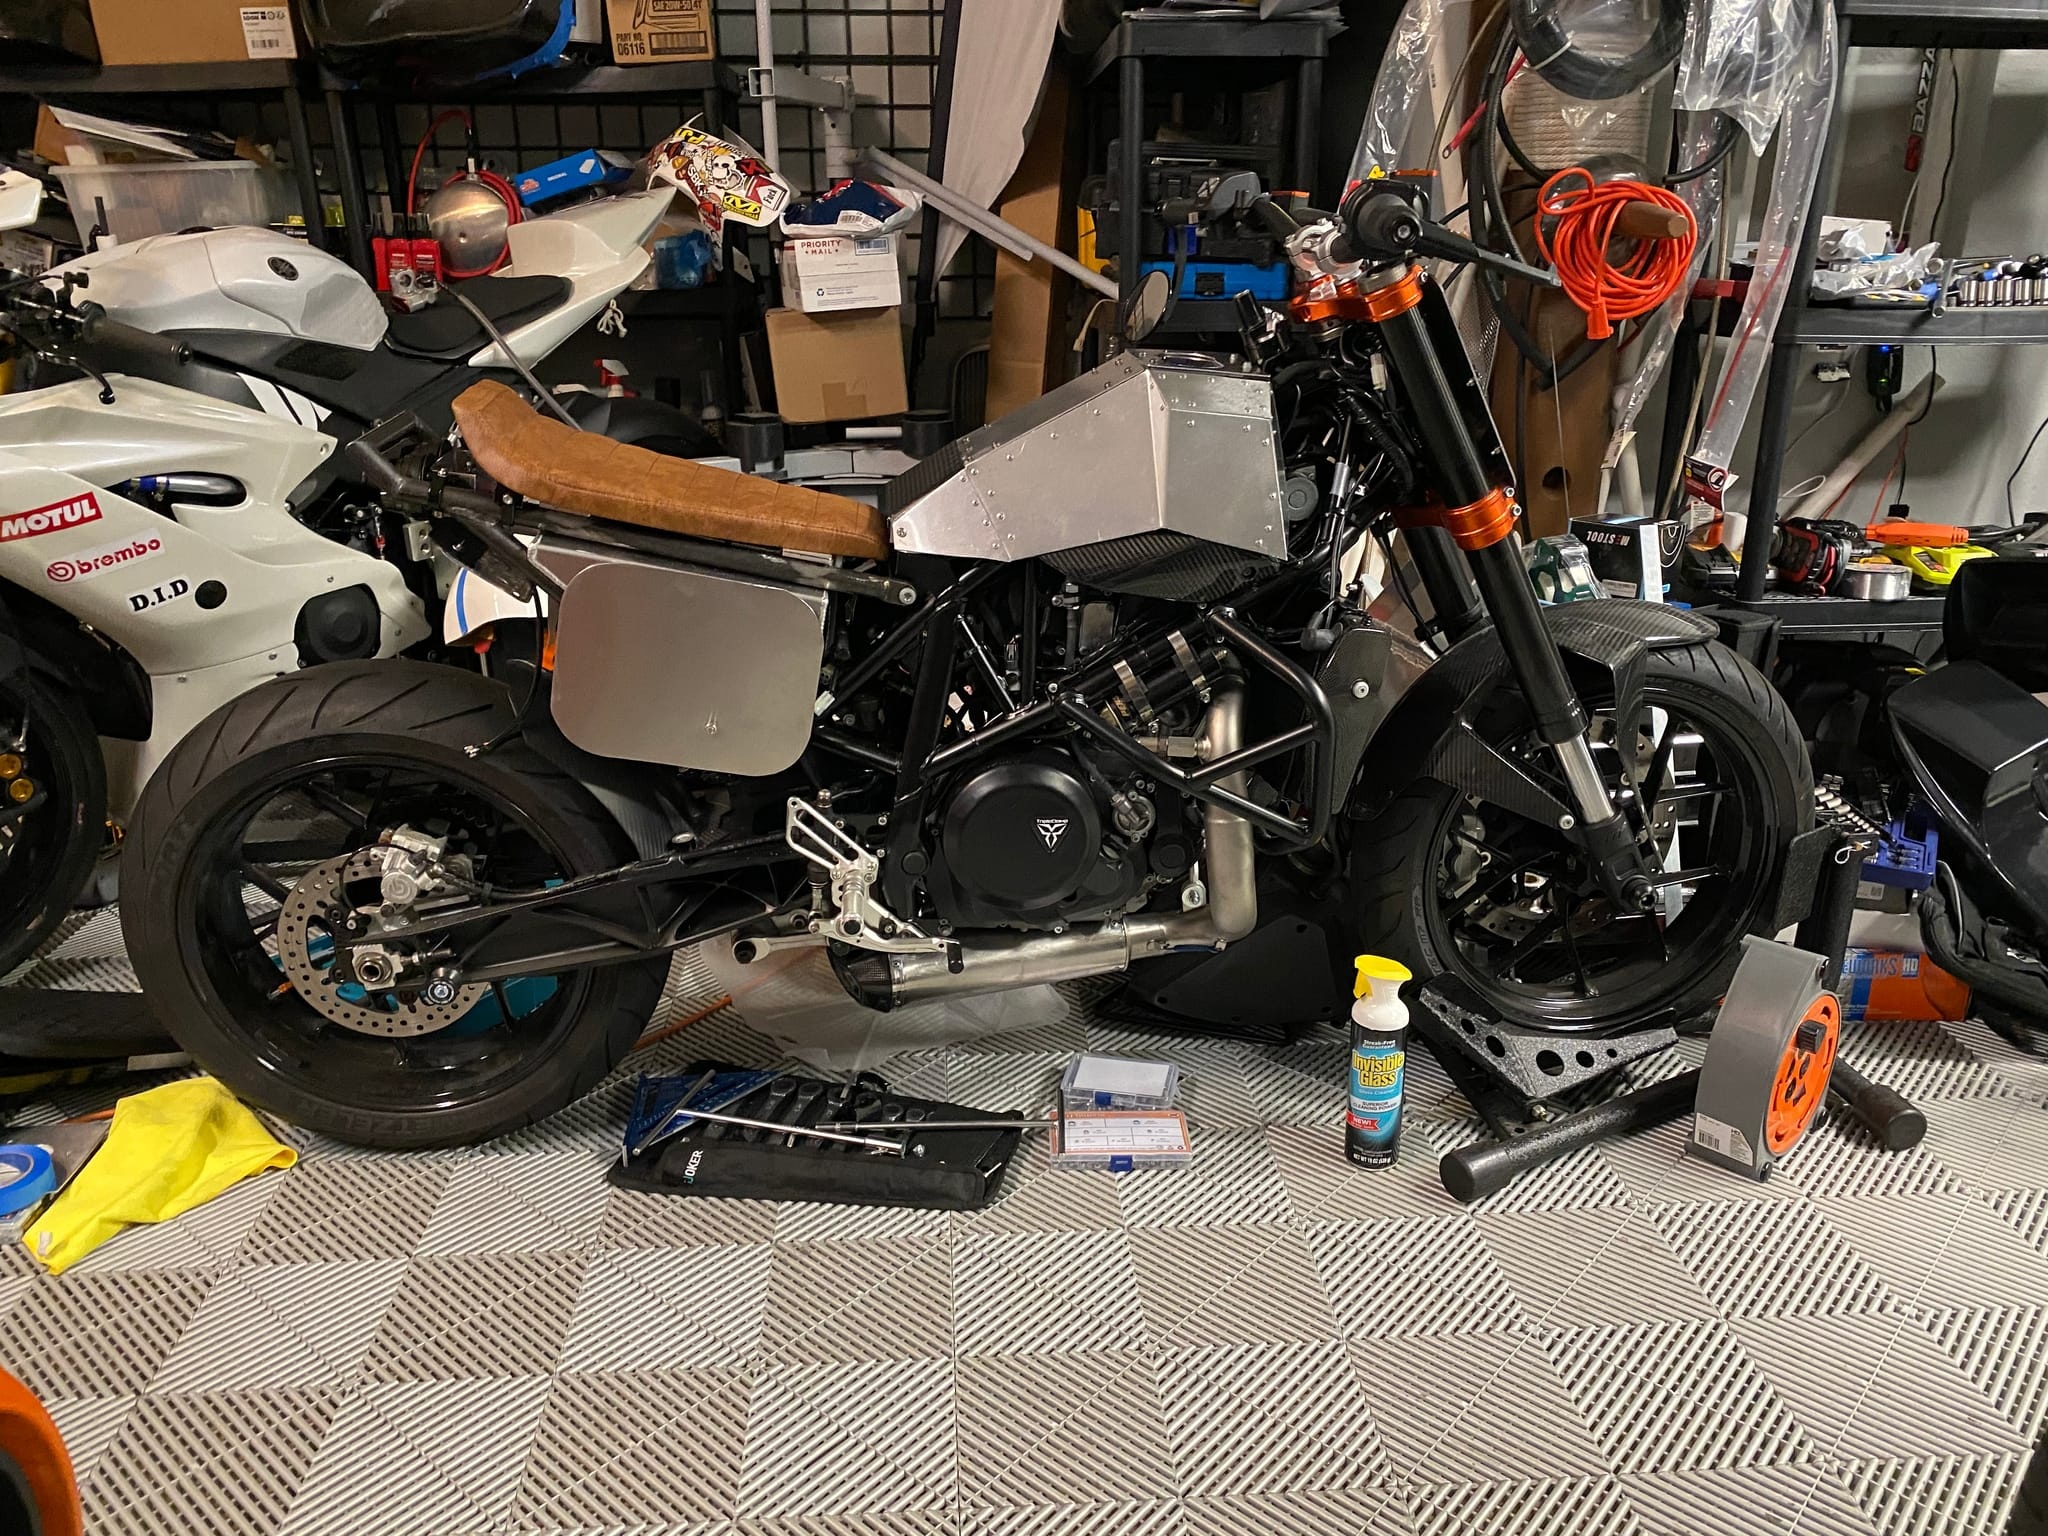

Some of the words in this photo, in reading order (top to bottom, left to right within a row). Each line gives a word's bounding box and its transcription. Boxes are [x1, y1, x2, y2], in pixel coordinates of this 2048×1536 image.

[616, 33, 631, 42] PART
[801, 239, 841, 249] PRIORITY
[1, 499, 97, 539] MOTUL
[76, 538, 161, 575] brembo
[129, 579, 189, 612] D.I.D
[1902, 957, 1919, 973] HD
[1352, 1050, 1404, 1073] Invisible
[1360, 1070, 1397, 1087] Glass
[683, 1150, 704, 1184] JOKER
